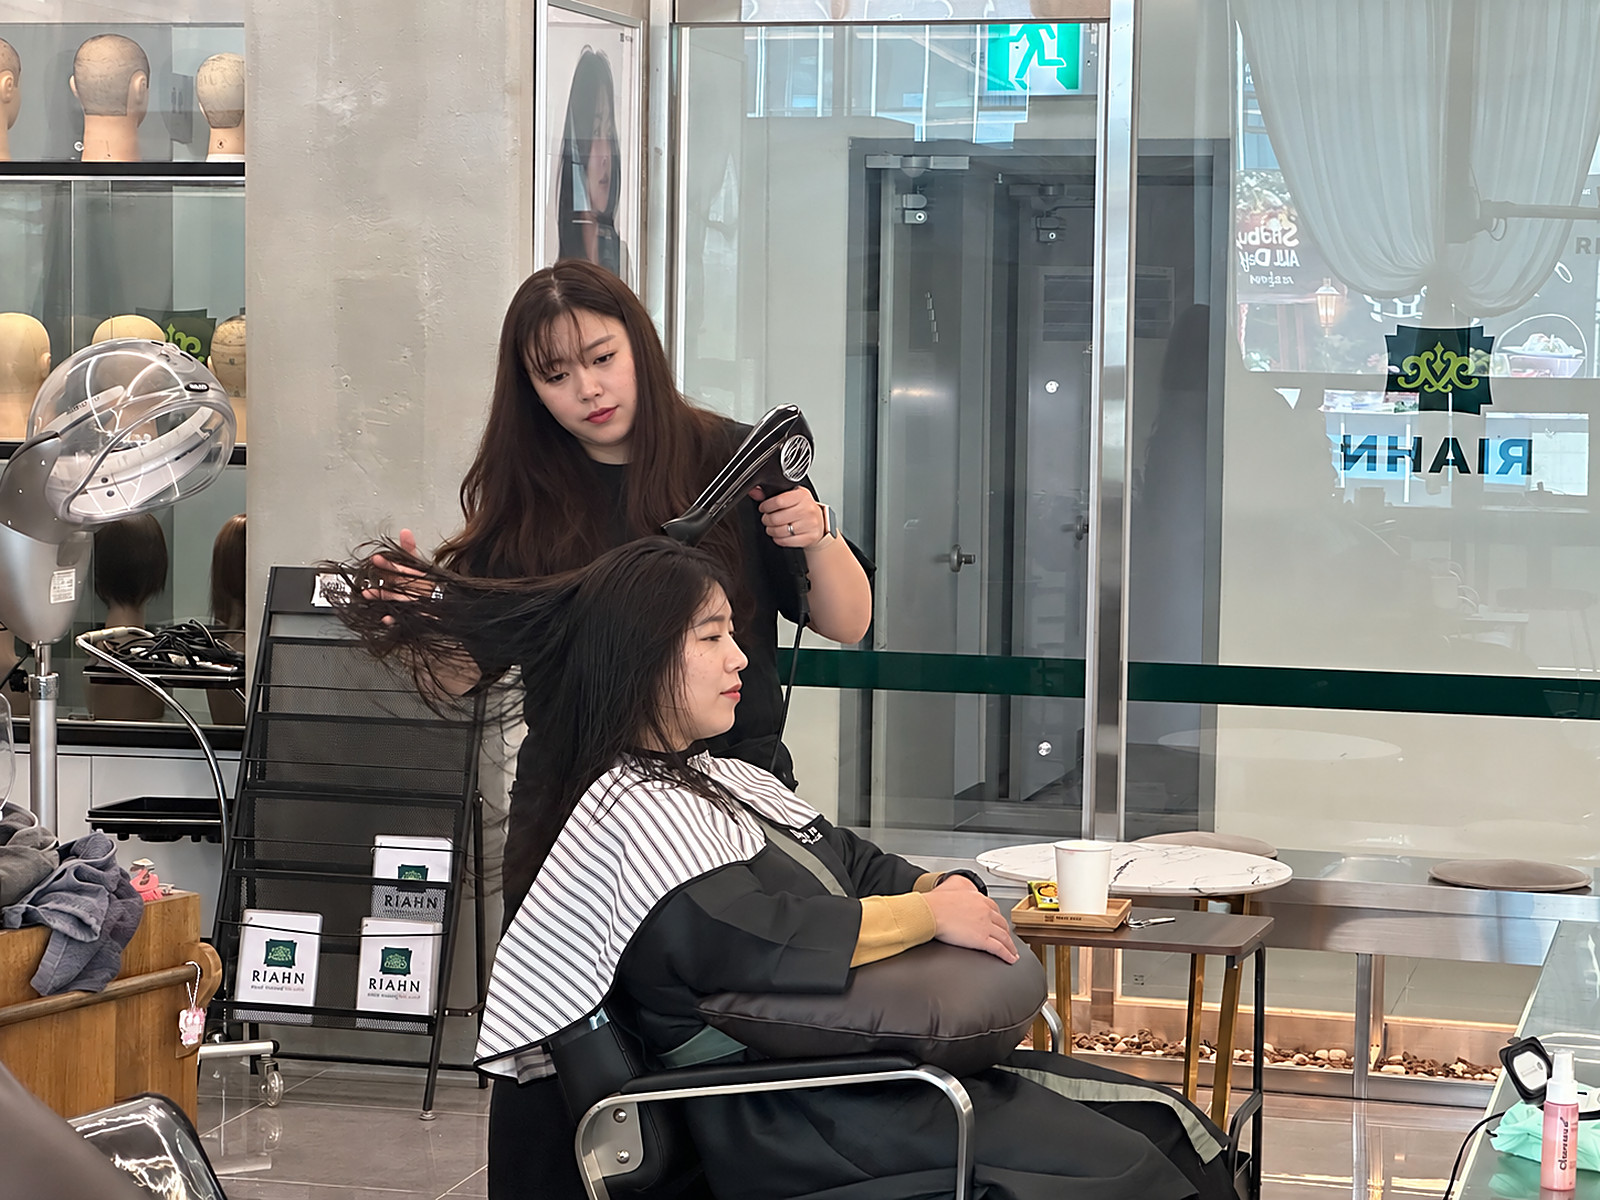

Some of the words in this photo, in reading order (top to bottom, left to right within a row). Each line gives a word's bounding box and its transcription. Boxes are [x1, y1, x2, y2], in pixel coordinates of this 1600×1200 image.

[384, 894, 438, 909] RIAHN
[252, 970, 305, 985] RIAHN
[368, 977, 420, 992] RIAHN
